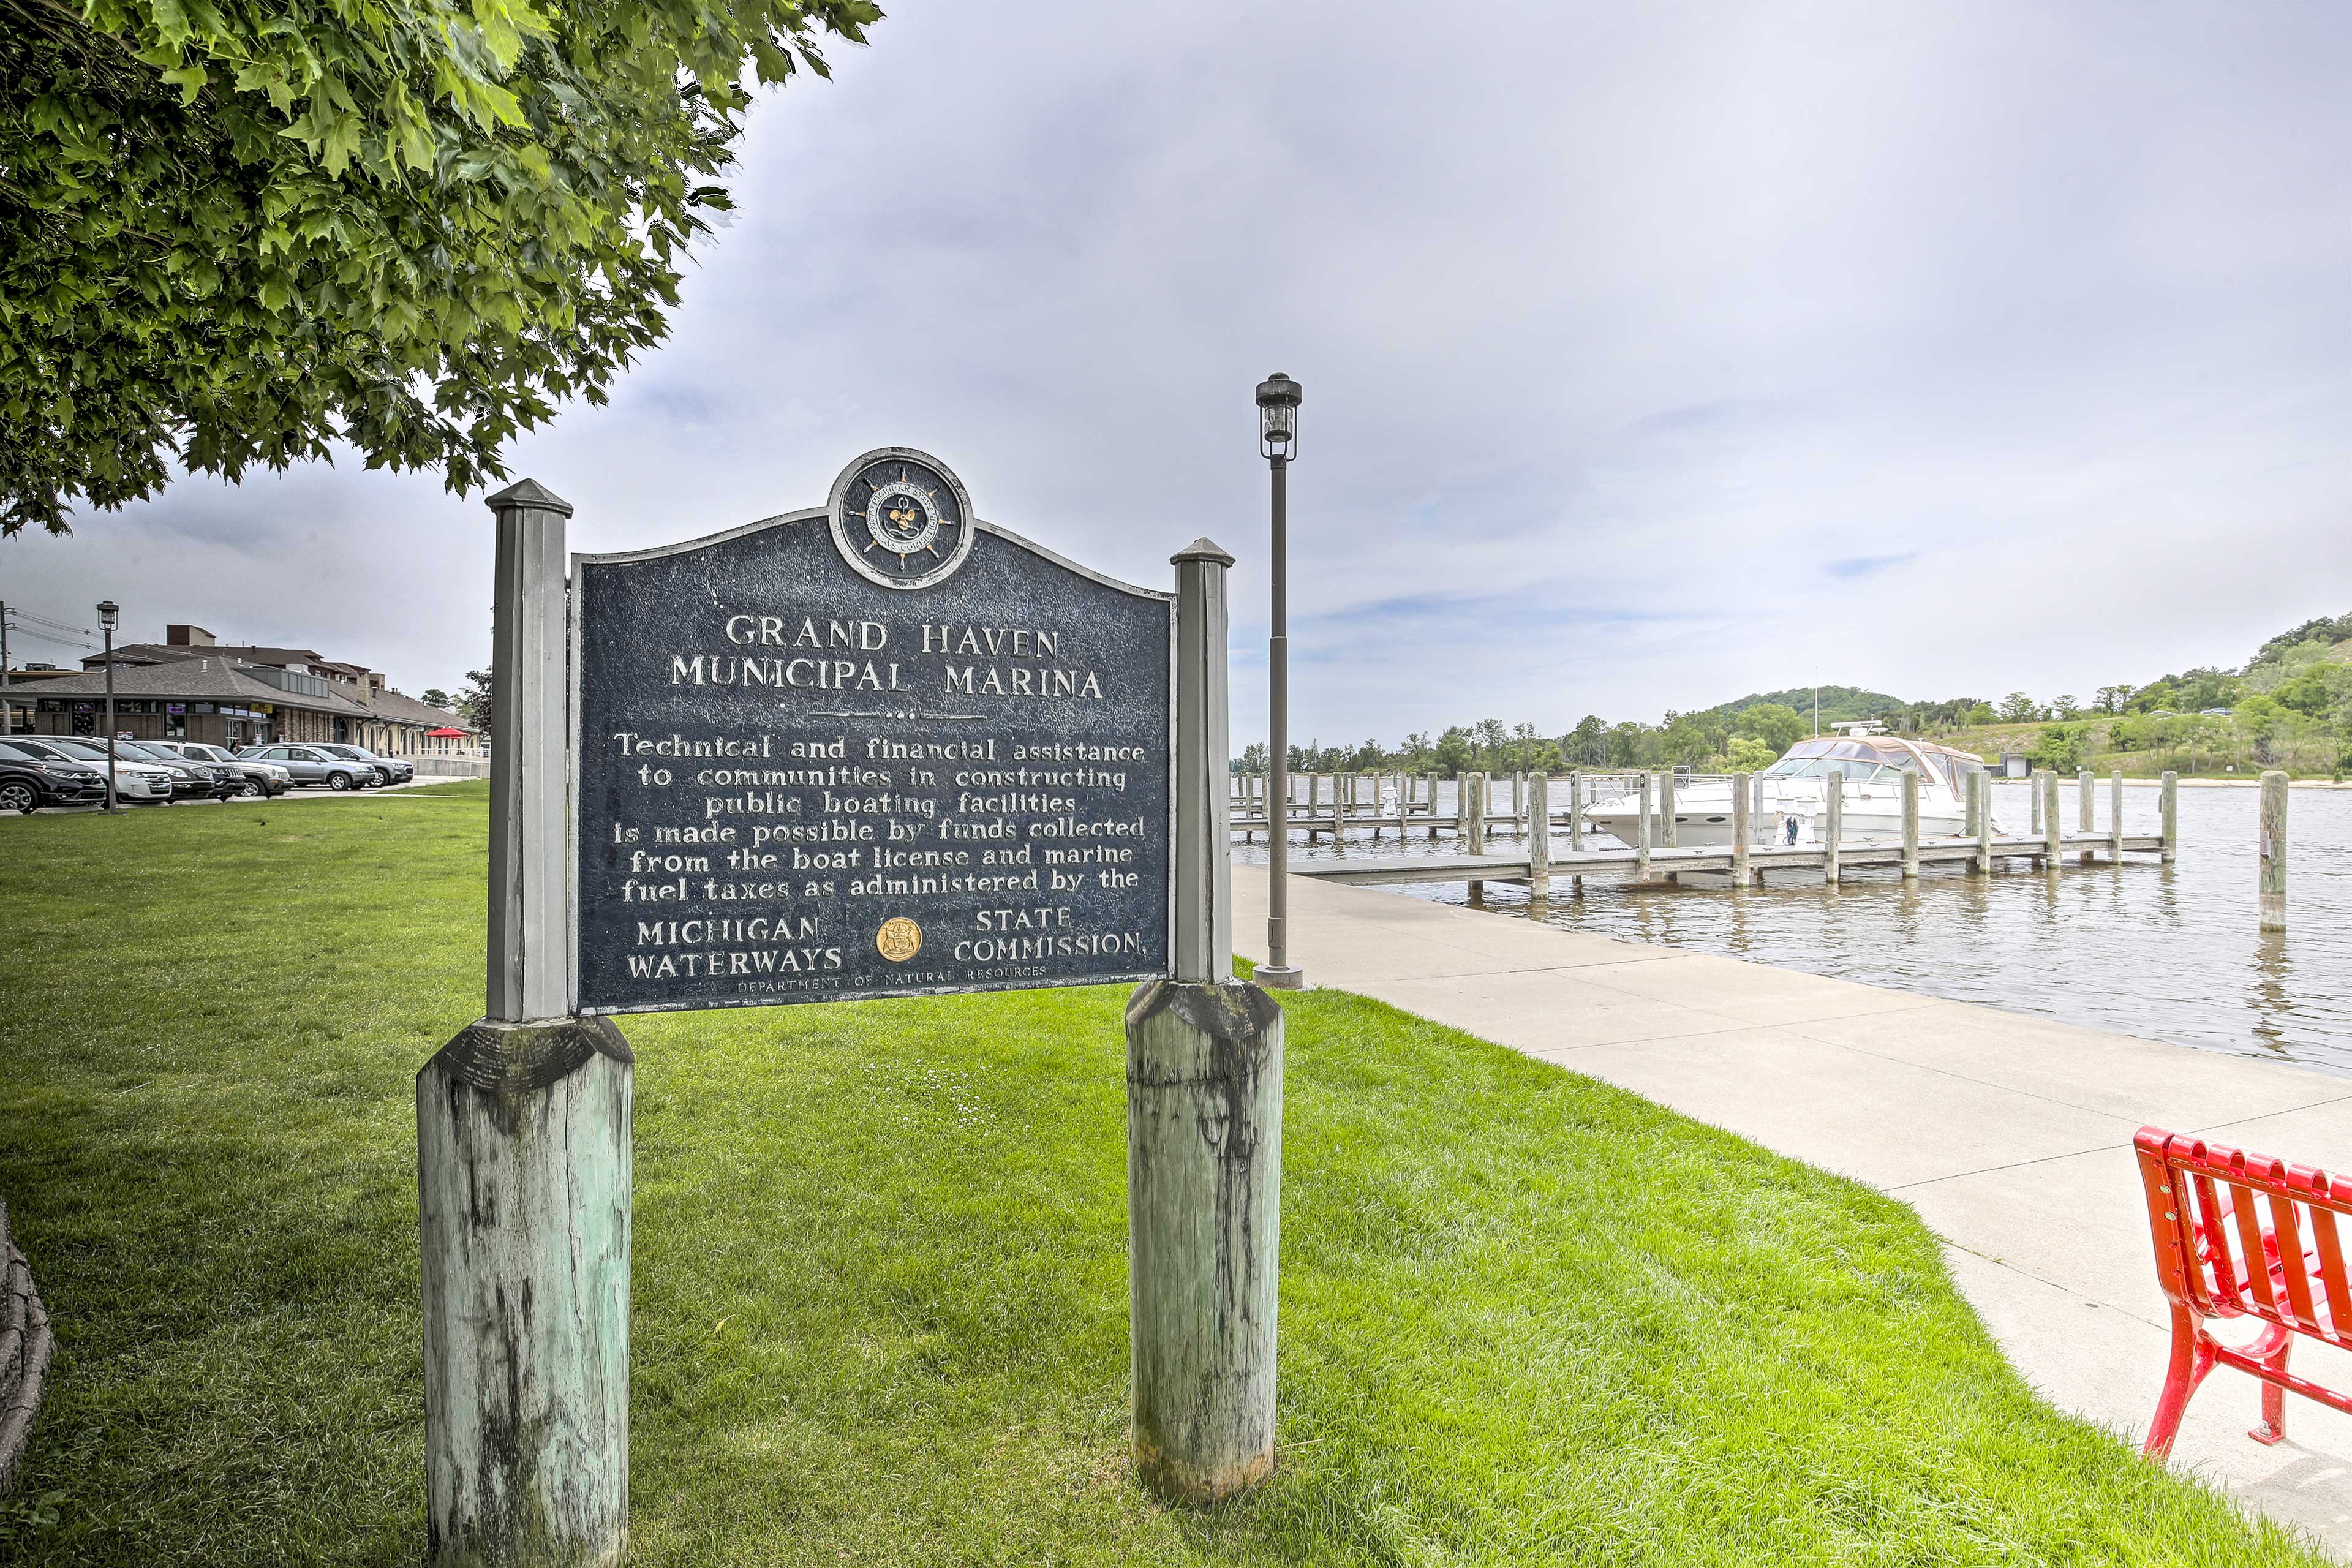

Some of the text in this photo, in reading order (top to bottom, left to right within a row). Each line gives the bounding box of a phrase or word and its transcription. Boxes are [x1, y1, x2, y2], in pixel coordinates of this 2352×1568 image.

[873, 484, 933, 511] MICHIGAN STATE
[869, 508, 937, 551] WATERWAYS COMMISSION
[726, 616, 1058, 657] GRAND HAVEN
[670, 655, 1103, 699] MUNICIPAL MARINA
[614, 733, 1144, 763] Technical and financial assistance
[638, 767, 1126, 793] to communities in constructing
[706, 791, 1075, 818] public boating facilities
[614, 817, 1144, 847] is made possible by funds collected
[630, 844, 1132, 872] from the boat license and marine
[621, 869, 1138, 902] fuel taxes as administered by the
[637, 907, 1072, 946] MICHIGAN STATE
[628, 948, 842, 979] WATERWAYS
[737, 966, 1047, 993] DEPARTMENT OF NATURAL RESOURCES
